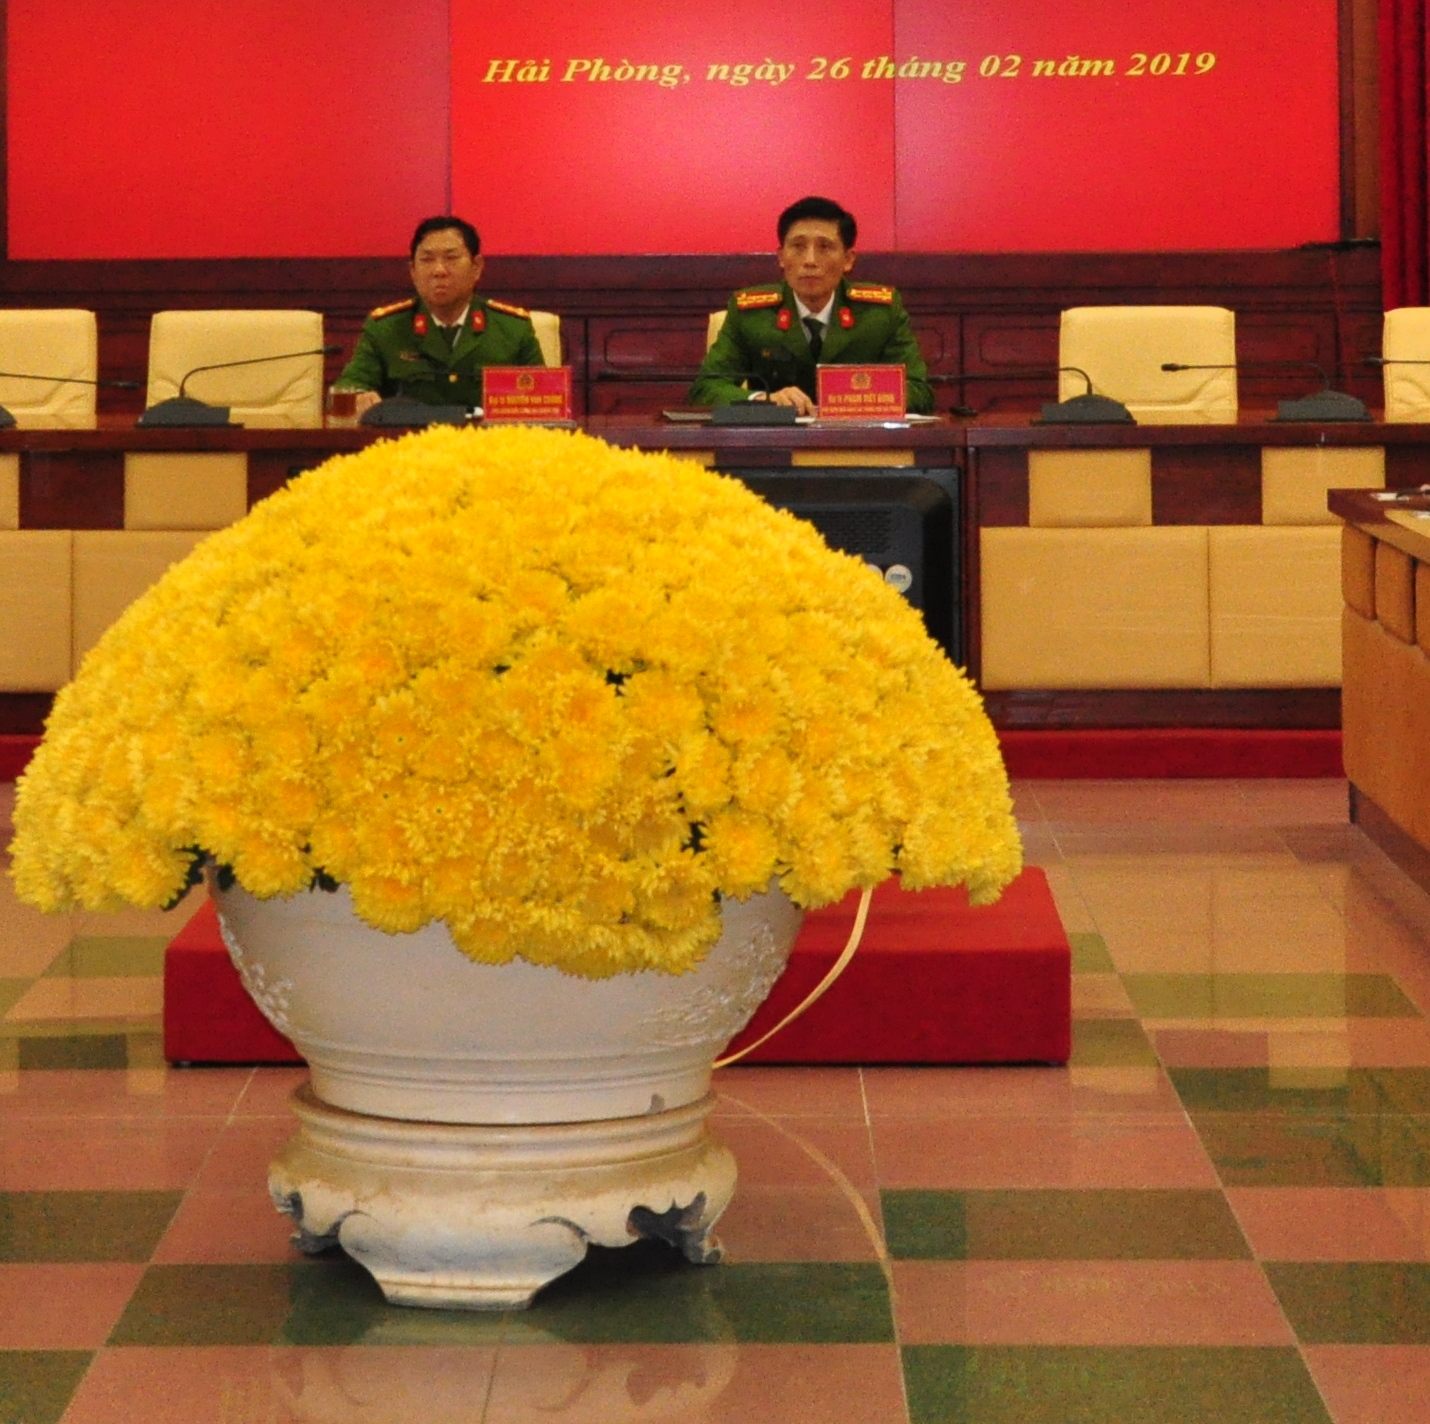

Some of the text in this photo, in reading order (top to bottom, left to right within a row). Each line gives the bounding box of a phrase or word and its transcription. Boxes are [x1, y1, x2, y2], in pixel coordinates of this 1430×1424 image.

[481, 51, 1217, 90] Hải Phòng, ngày 26 tháng 02 năm 2019
